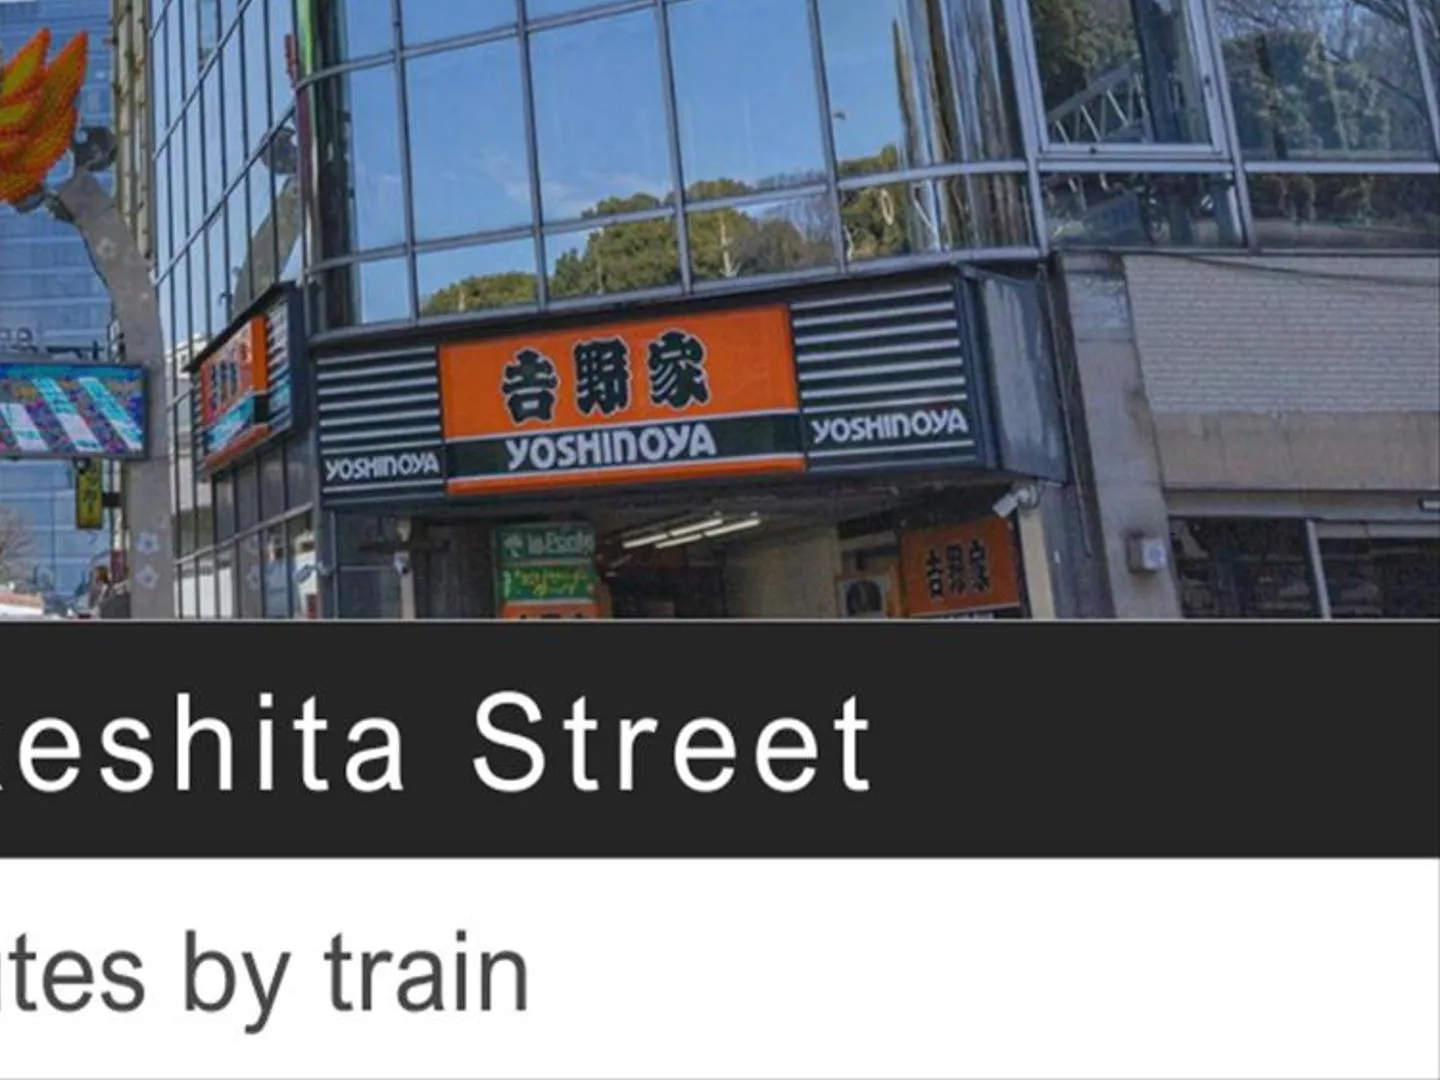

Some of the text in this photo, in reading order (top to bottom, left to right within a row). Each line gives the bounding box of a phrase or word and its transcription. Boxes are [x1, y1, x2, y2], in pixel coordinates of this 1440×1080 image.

[502, 328, 712, 426] 吉野家
[504, 421, 718, 472] YOSHINOYA
[811, 407, 970, 445] YOSHINOYA
[323, 451, 441, 483] YOSHINOYA
